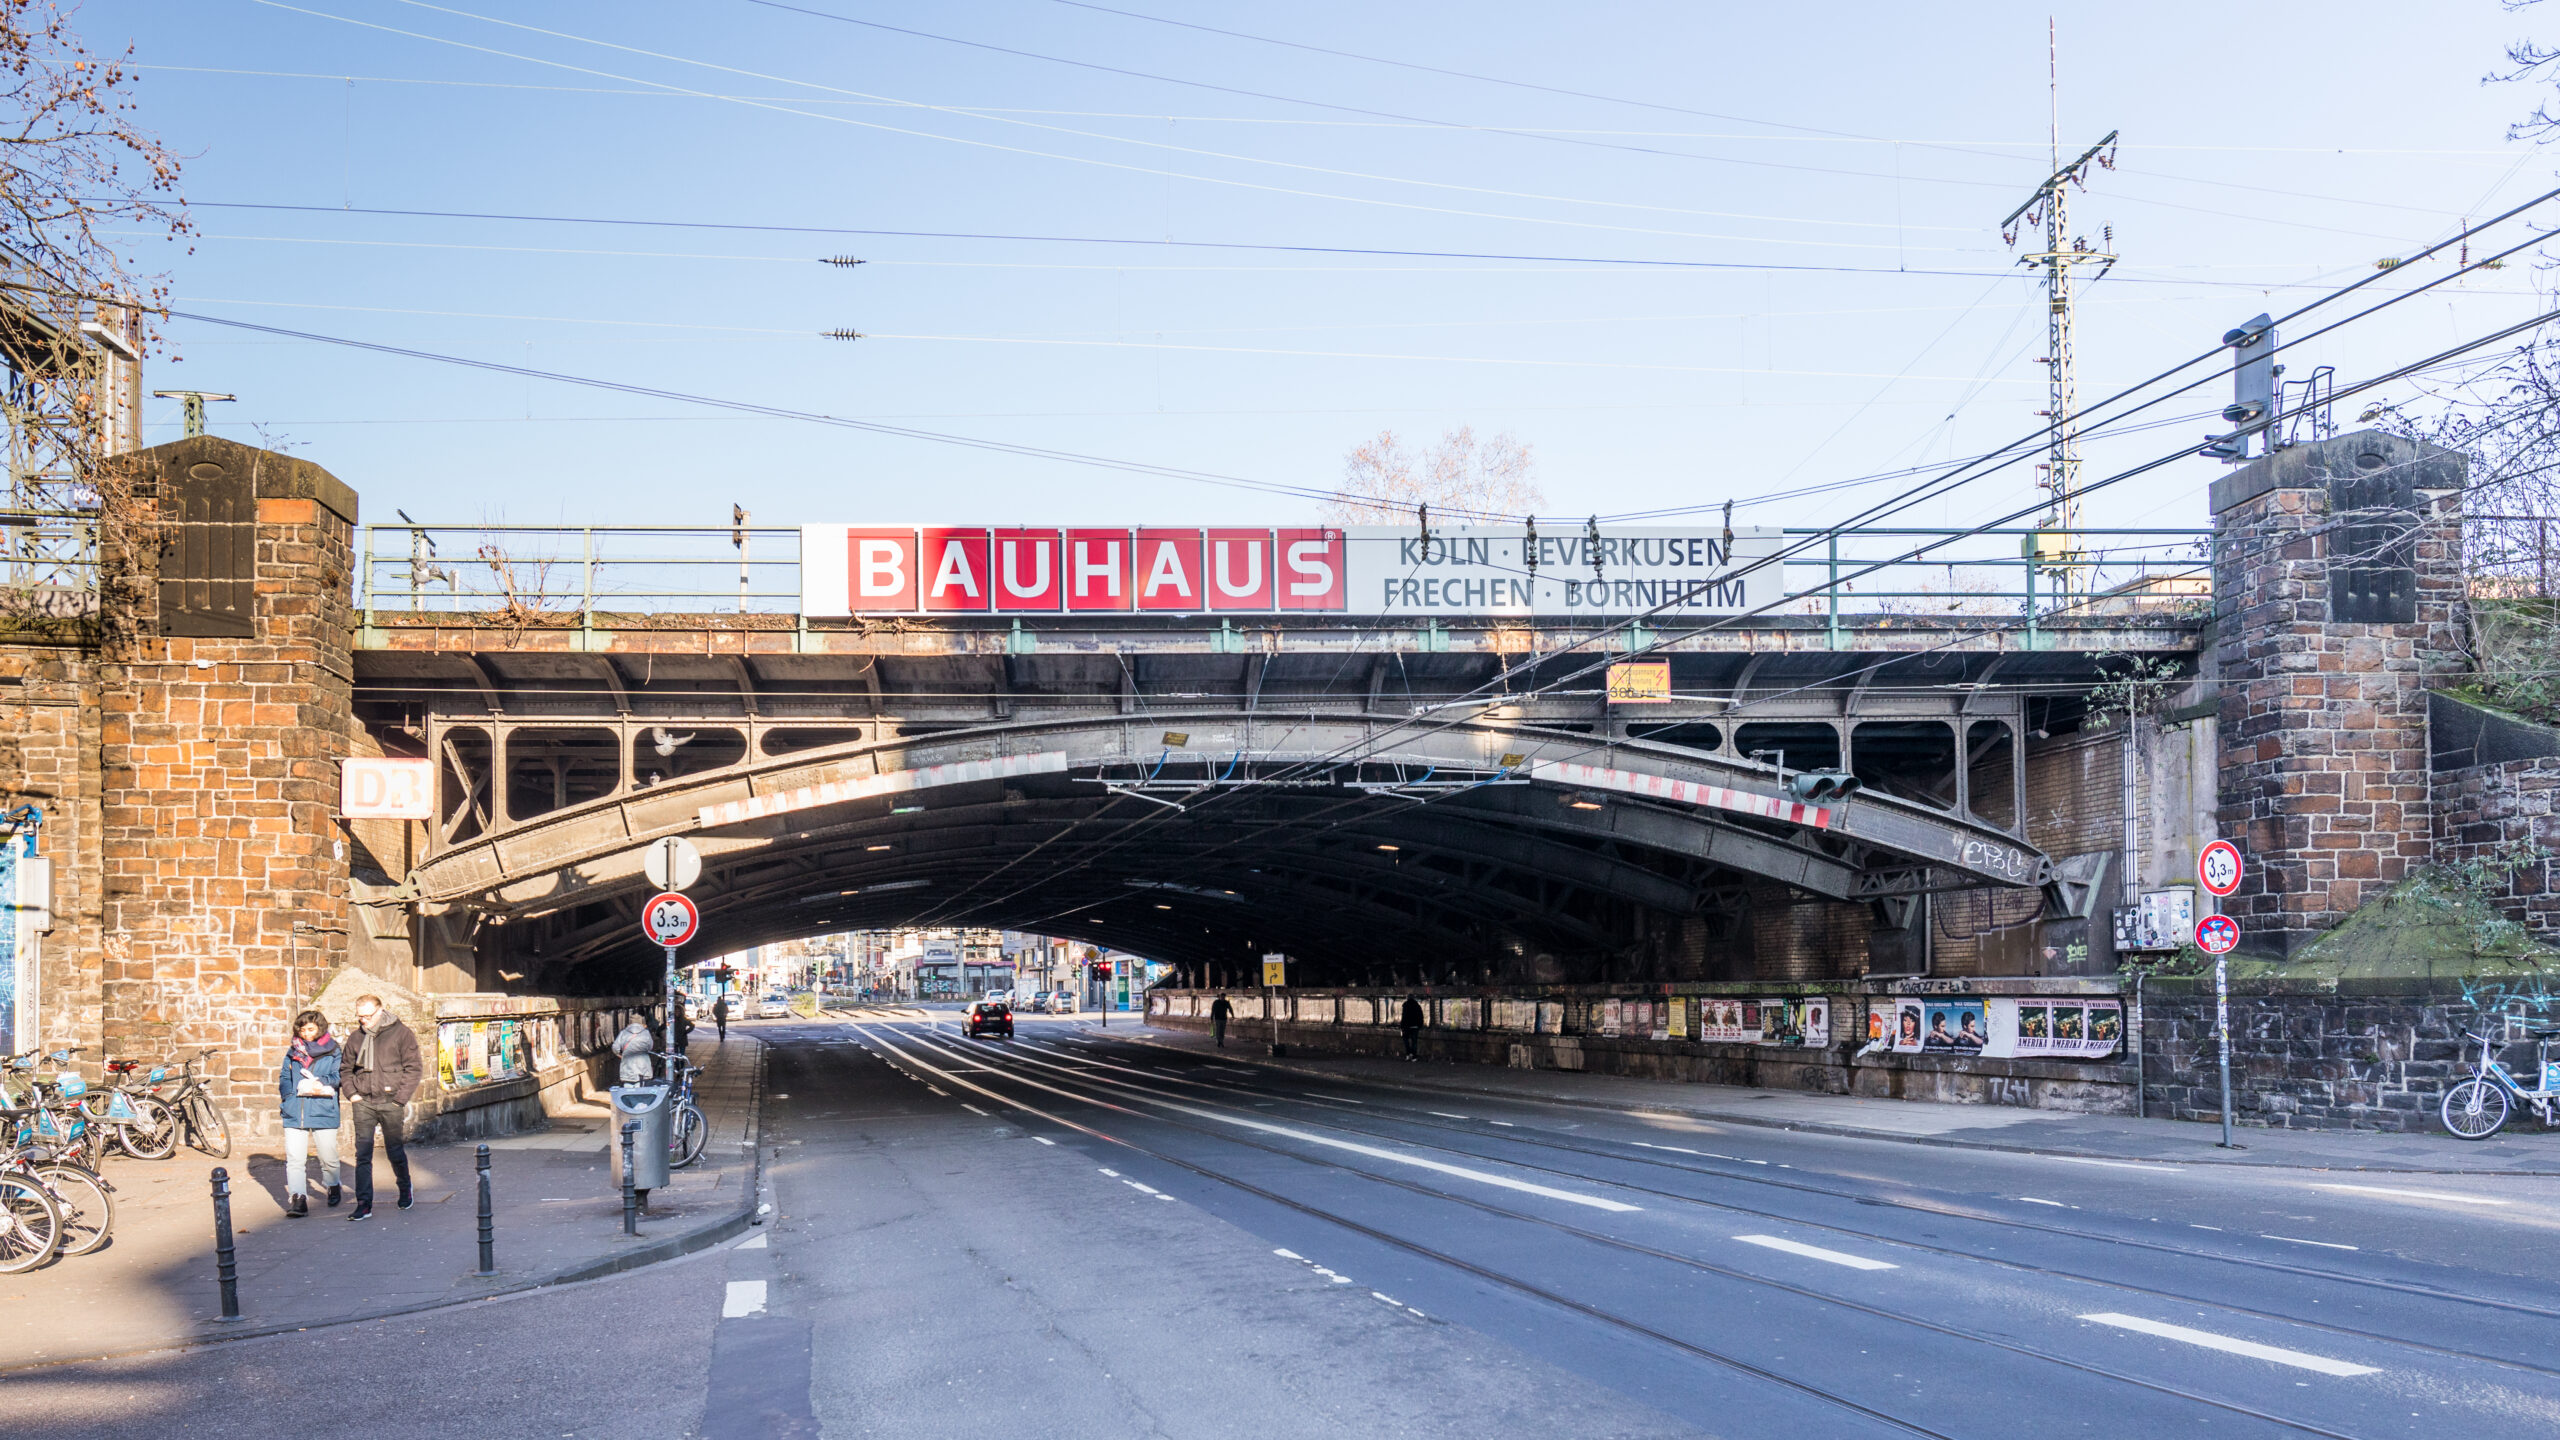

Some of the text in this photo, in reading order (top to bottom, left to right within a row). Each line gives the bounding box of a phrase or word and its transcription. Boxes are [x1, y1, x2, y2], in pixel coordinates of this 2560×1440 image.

[1401, 529, 1489, 566] KÖLN
[859, 539, 1334, 598] BAUHAUS
[1384, 578, 1745, 607] FRECHEN BORNHEIM
[354, 768, 423, 809] DB
[2018, 1038, 2047, 1048] AMERIKA
[2052, 1039, 2081, 1049] AMERIKA
